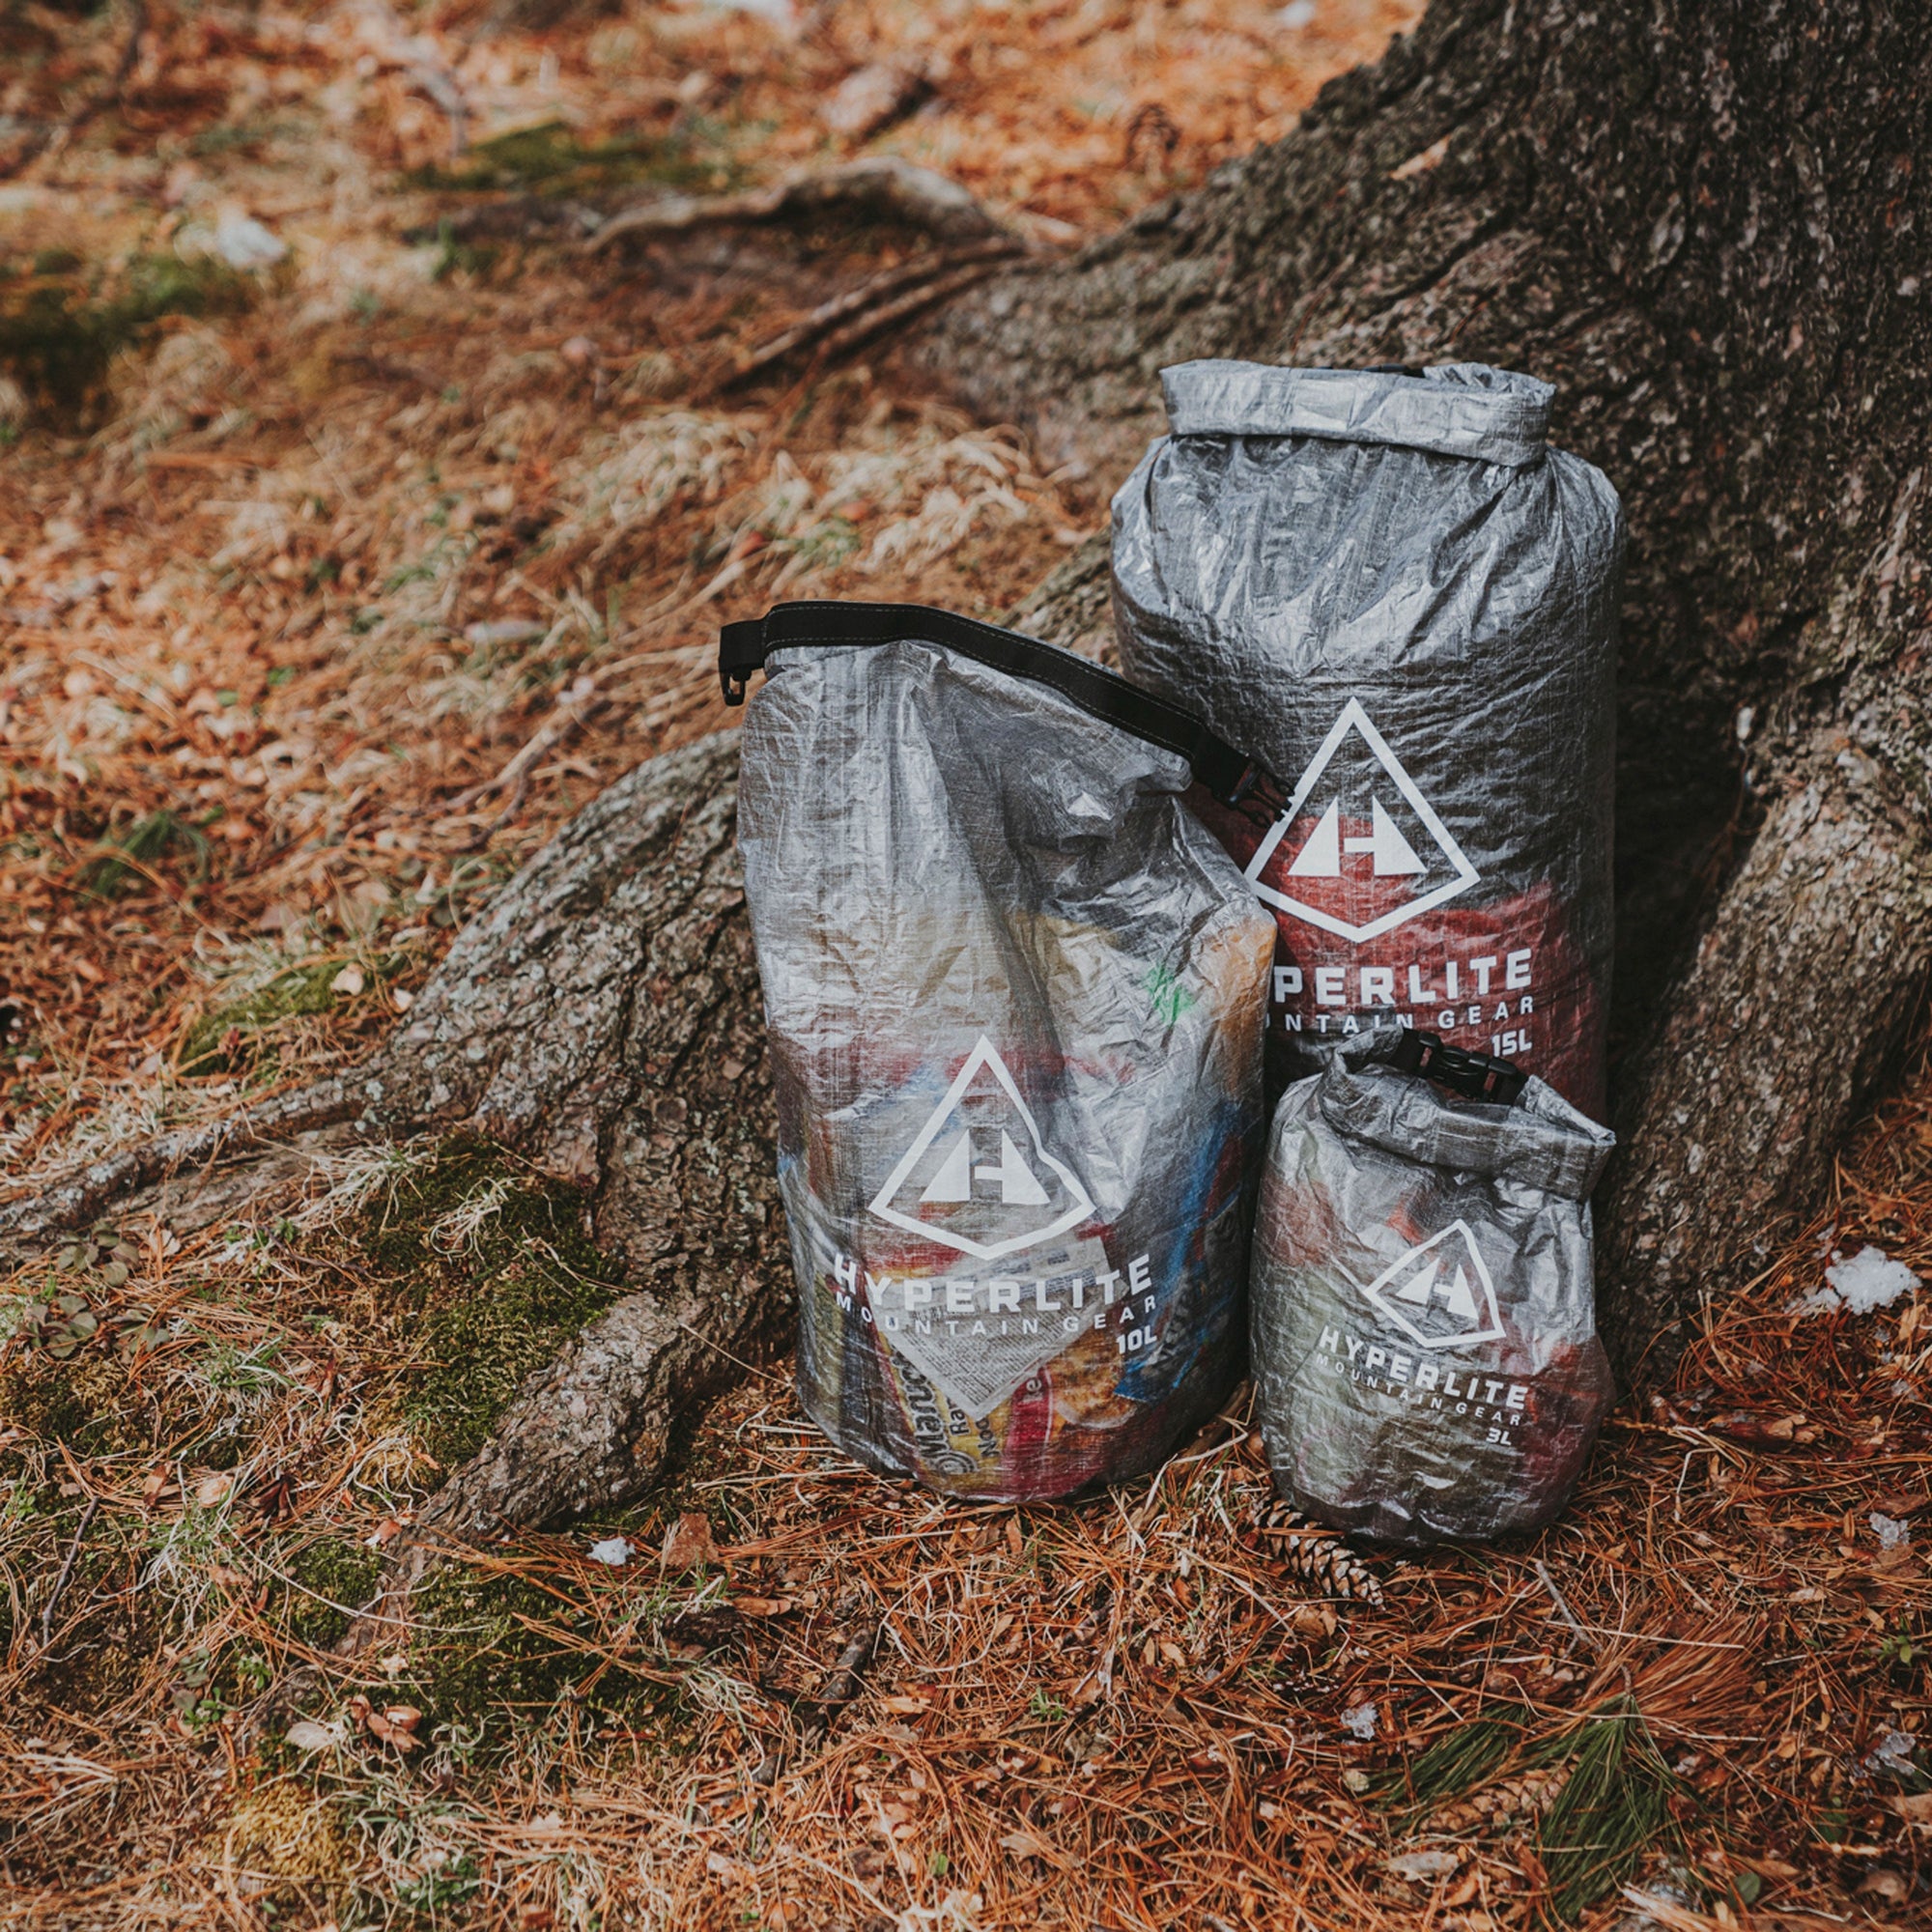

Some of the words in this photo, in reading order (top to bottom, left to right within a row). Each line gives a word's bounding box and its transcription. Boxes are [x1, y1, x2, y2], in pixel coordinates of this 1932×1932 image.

[1273, 948, 1532, 1006] PERLITE
[1266, 1012, 1413, 1034] NTAIN
[1437, 995, 1534, 1030] GEAR
[1492, 1028, 1533, 1058] 15L
[834, 1253, 1152, 1313] HYPERLITE
[835, 1292, 1038, 1336] MOUNTAIN
[1063, 1293, 1157, 1332] GEAR
[1116, 1325, 1158, 1354] 10L
[1319, 1325, 1529, 1410] HYPERLITE
[1316, 1353, 1443, 1409] MOUNTAIN
[1455, 1402, 1522, 1427] GEAR
[1485, 1427, 1512, 1446] 3L
